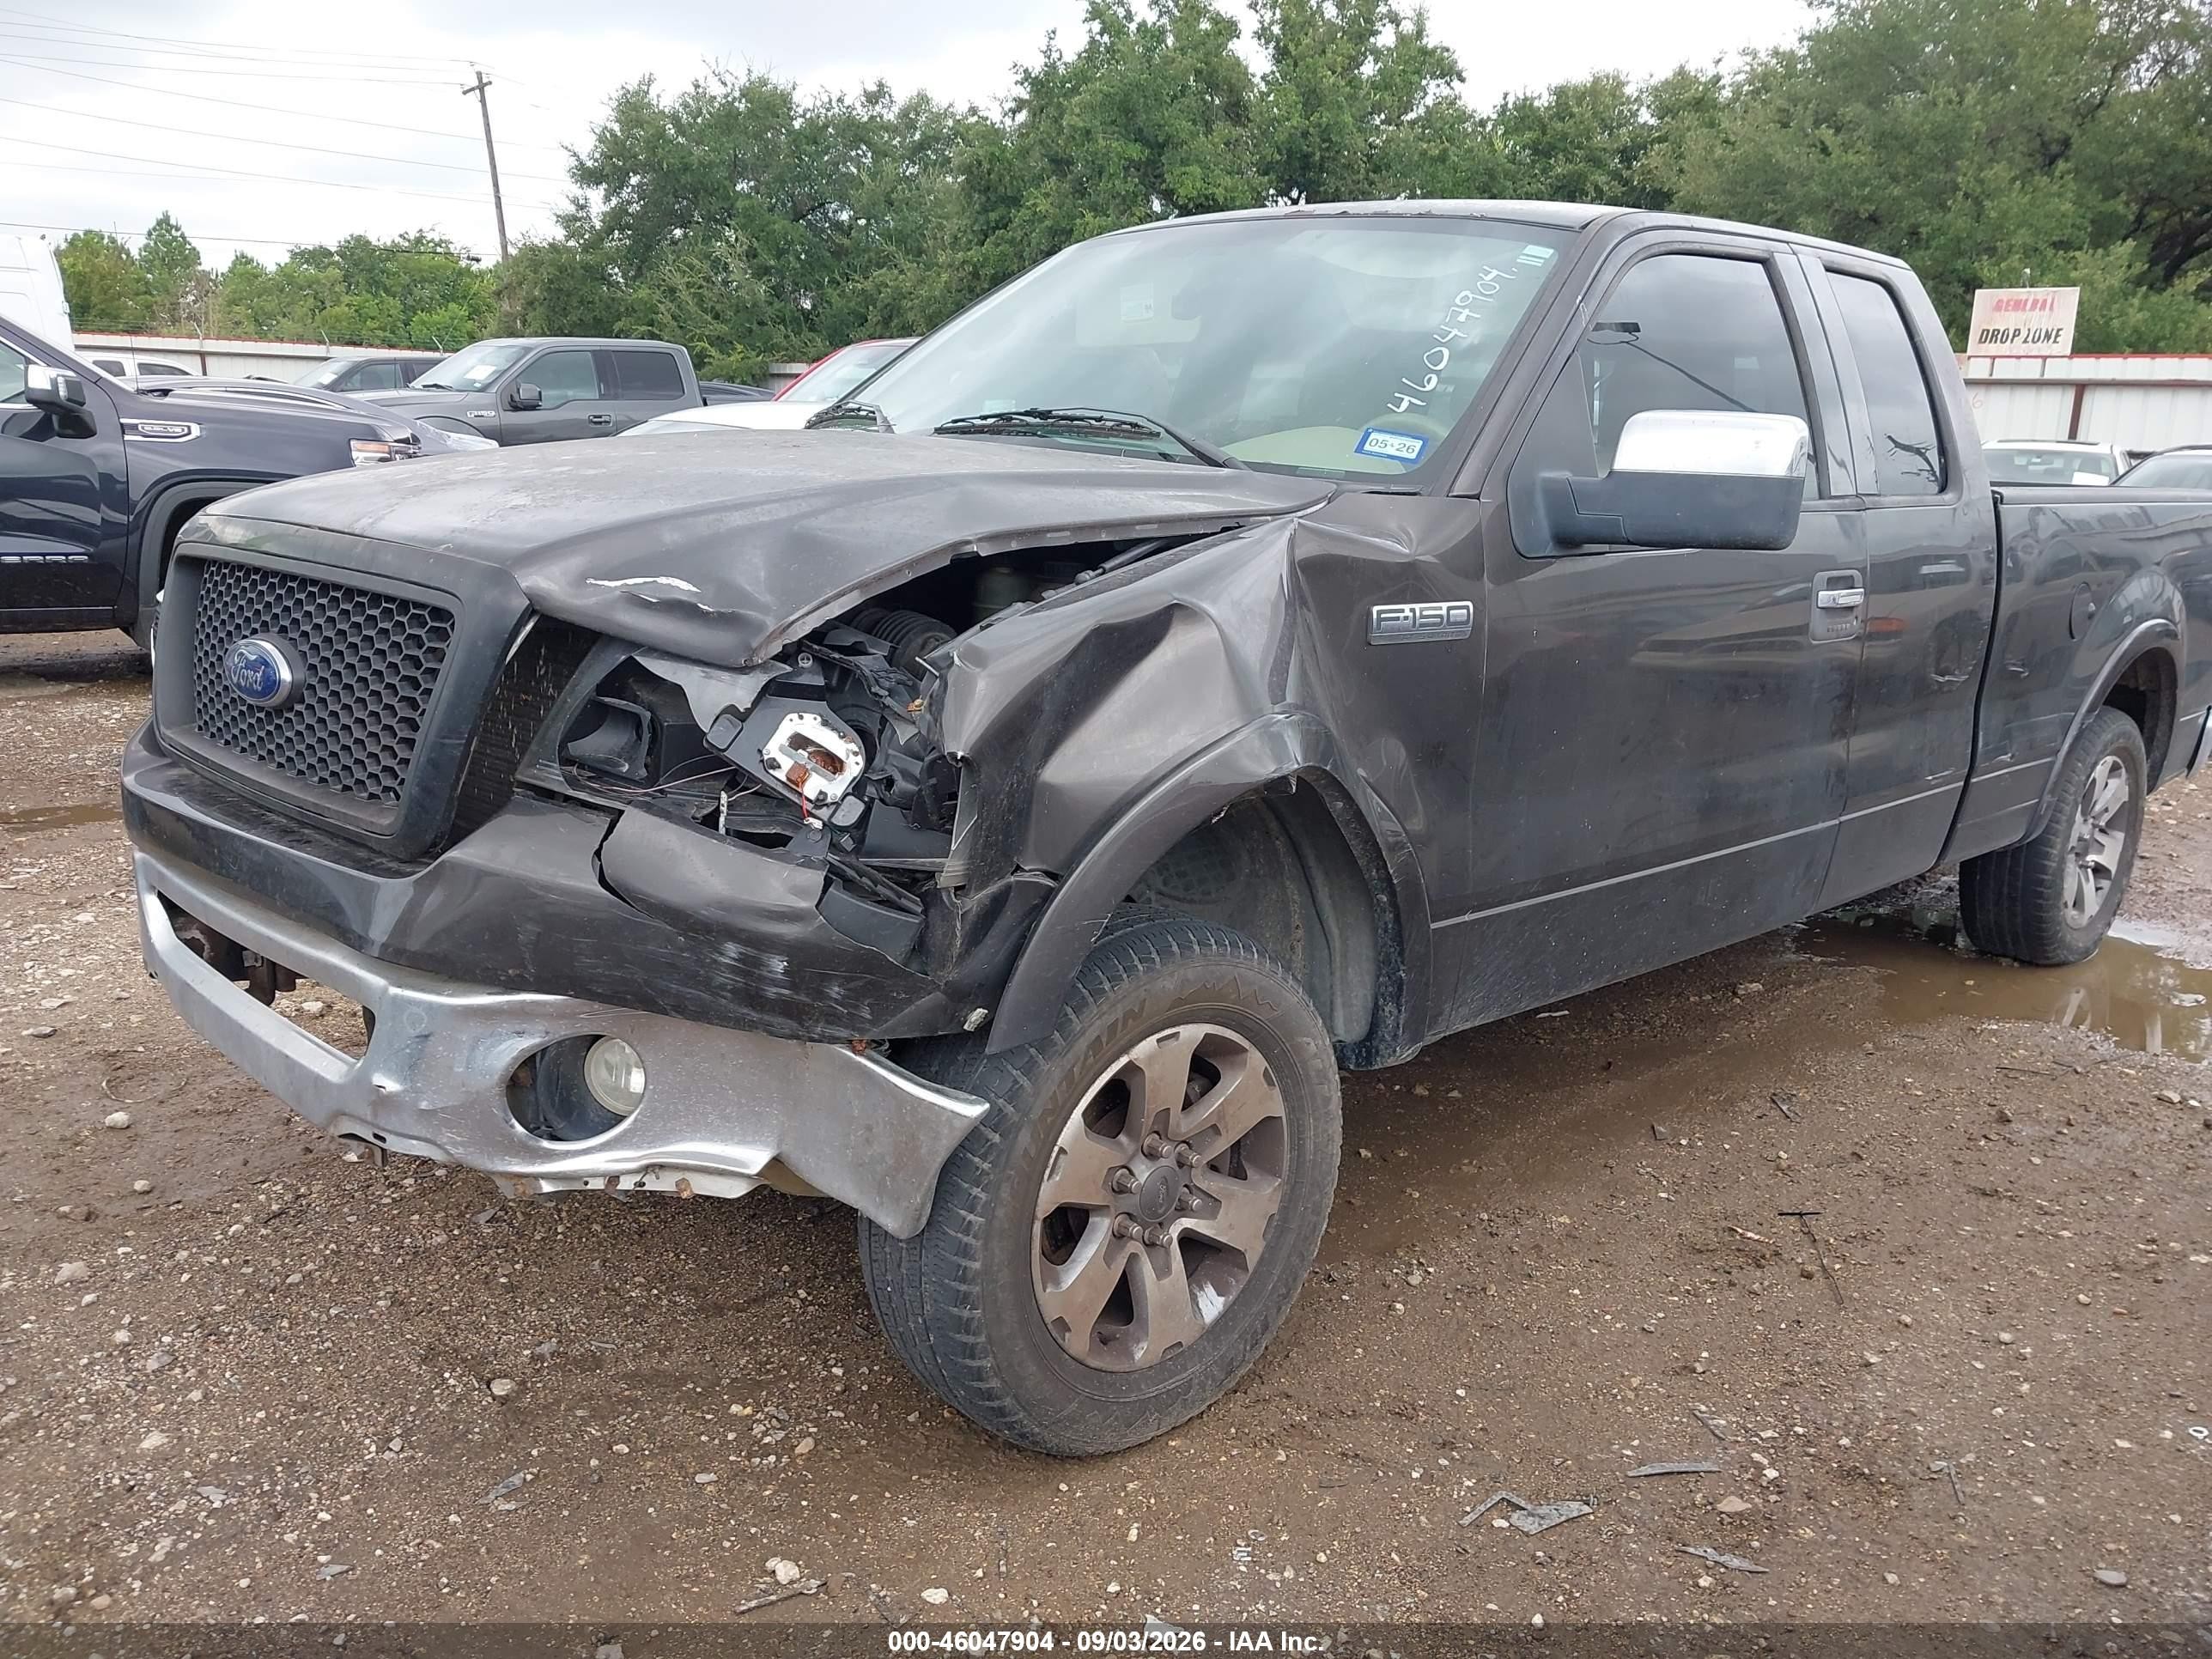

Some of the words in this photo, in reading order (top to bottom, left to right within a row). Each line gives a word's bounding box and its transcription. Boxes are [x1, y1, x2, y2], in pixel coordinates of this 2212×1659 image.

[1978, 328, 2021, 344] DROP
[1395, 443, 1416, 453] 26
[1376, 604, 1471, 632] F-150
[231, 649, 265, 691] Ford
